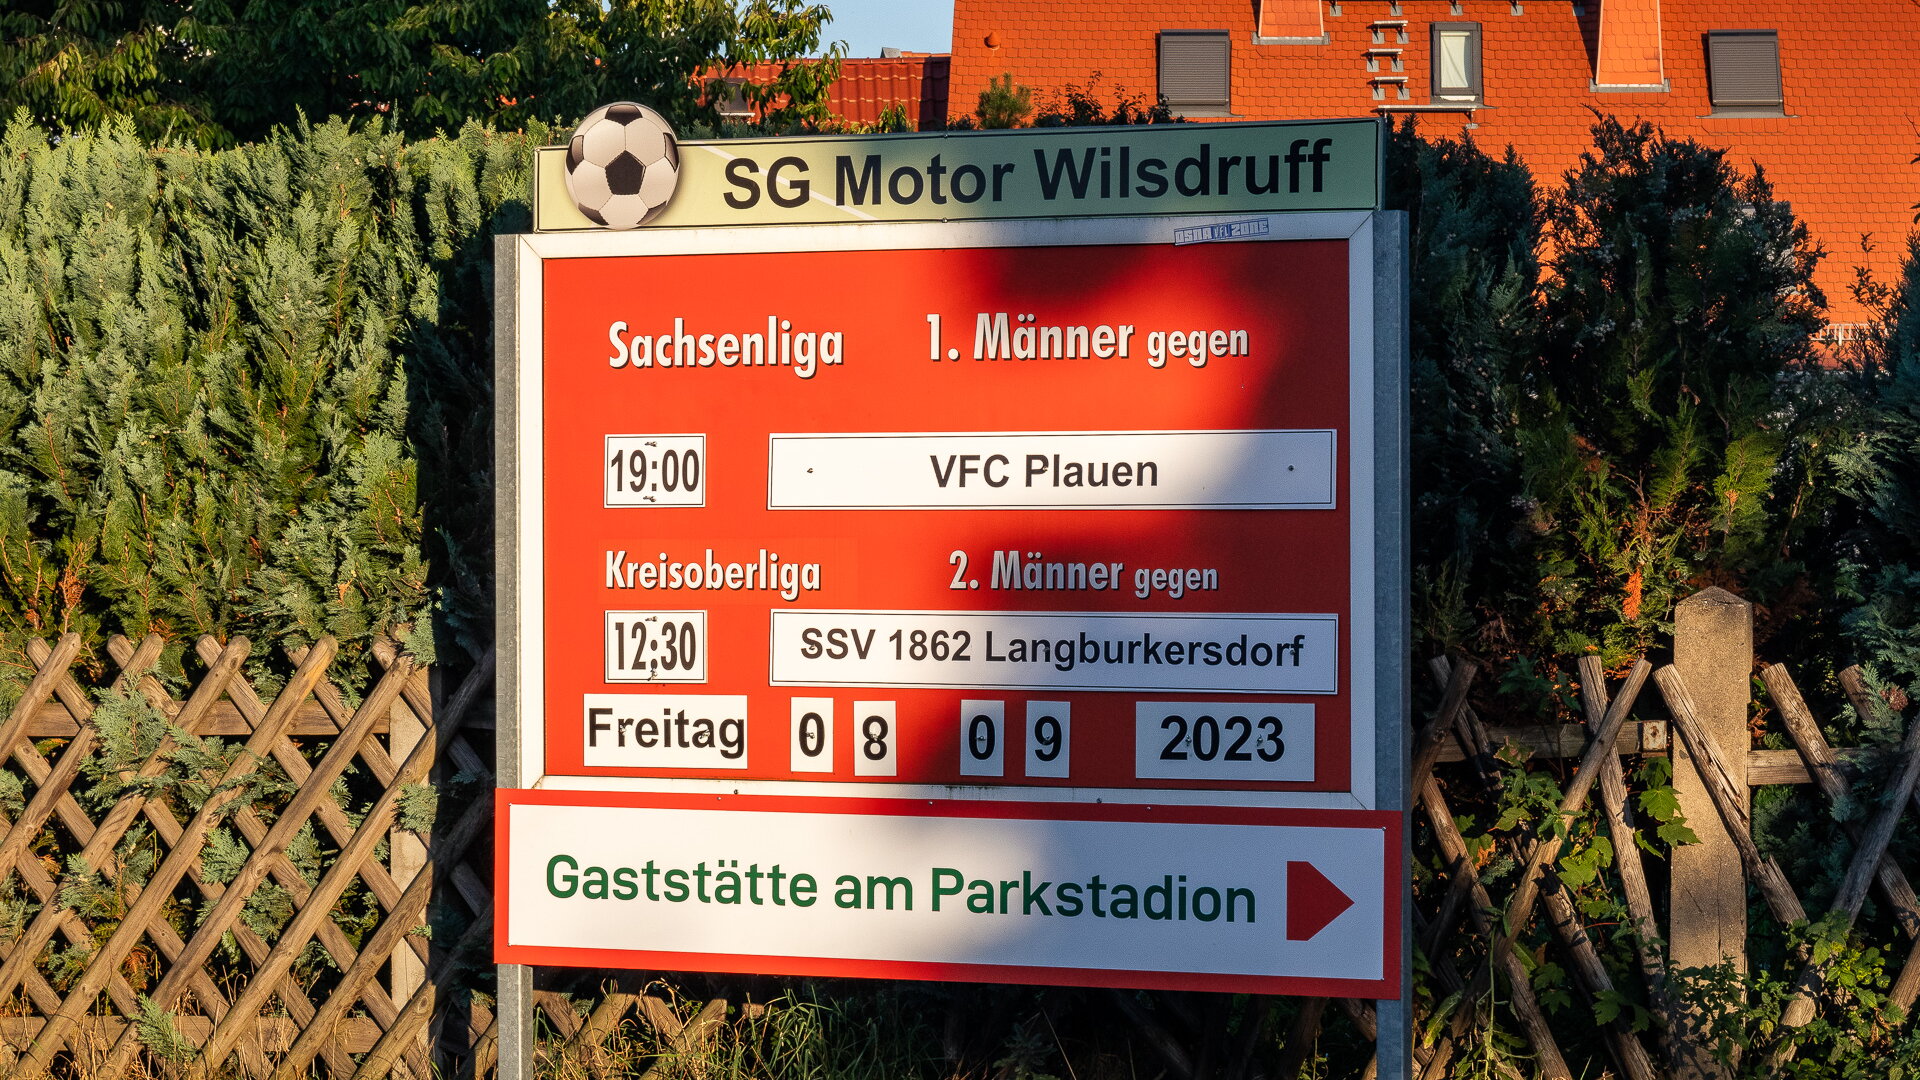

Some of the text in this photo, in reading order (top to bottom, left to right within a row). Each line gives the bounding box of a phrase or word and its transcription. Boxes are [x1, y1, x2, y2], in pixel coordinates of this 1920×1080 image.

[723, 138, 1332, 209] SG Motor Wilsdruff
[608, 315, 844, 379] Sachsenliga
[926, 312, 1250, 368] 1. Männer gegen
[611, 449, 700, 493] 19:00
[930, 453, 1159, 488] VFC Plauen
[605, 548, 821, 601] Kreisoberliga
[949, 550, 1219, 599] 2. Männer gegen
[800, 628, 1305, 672] SSV 1862 Langburkersdorf
[588, 707, 745, 759] Freitag
[1159, 715, 1285, 762] 2023
[546, 853, 1257, 924] Gaststätte am Parkstadion
